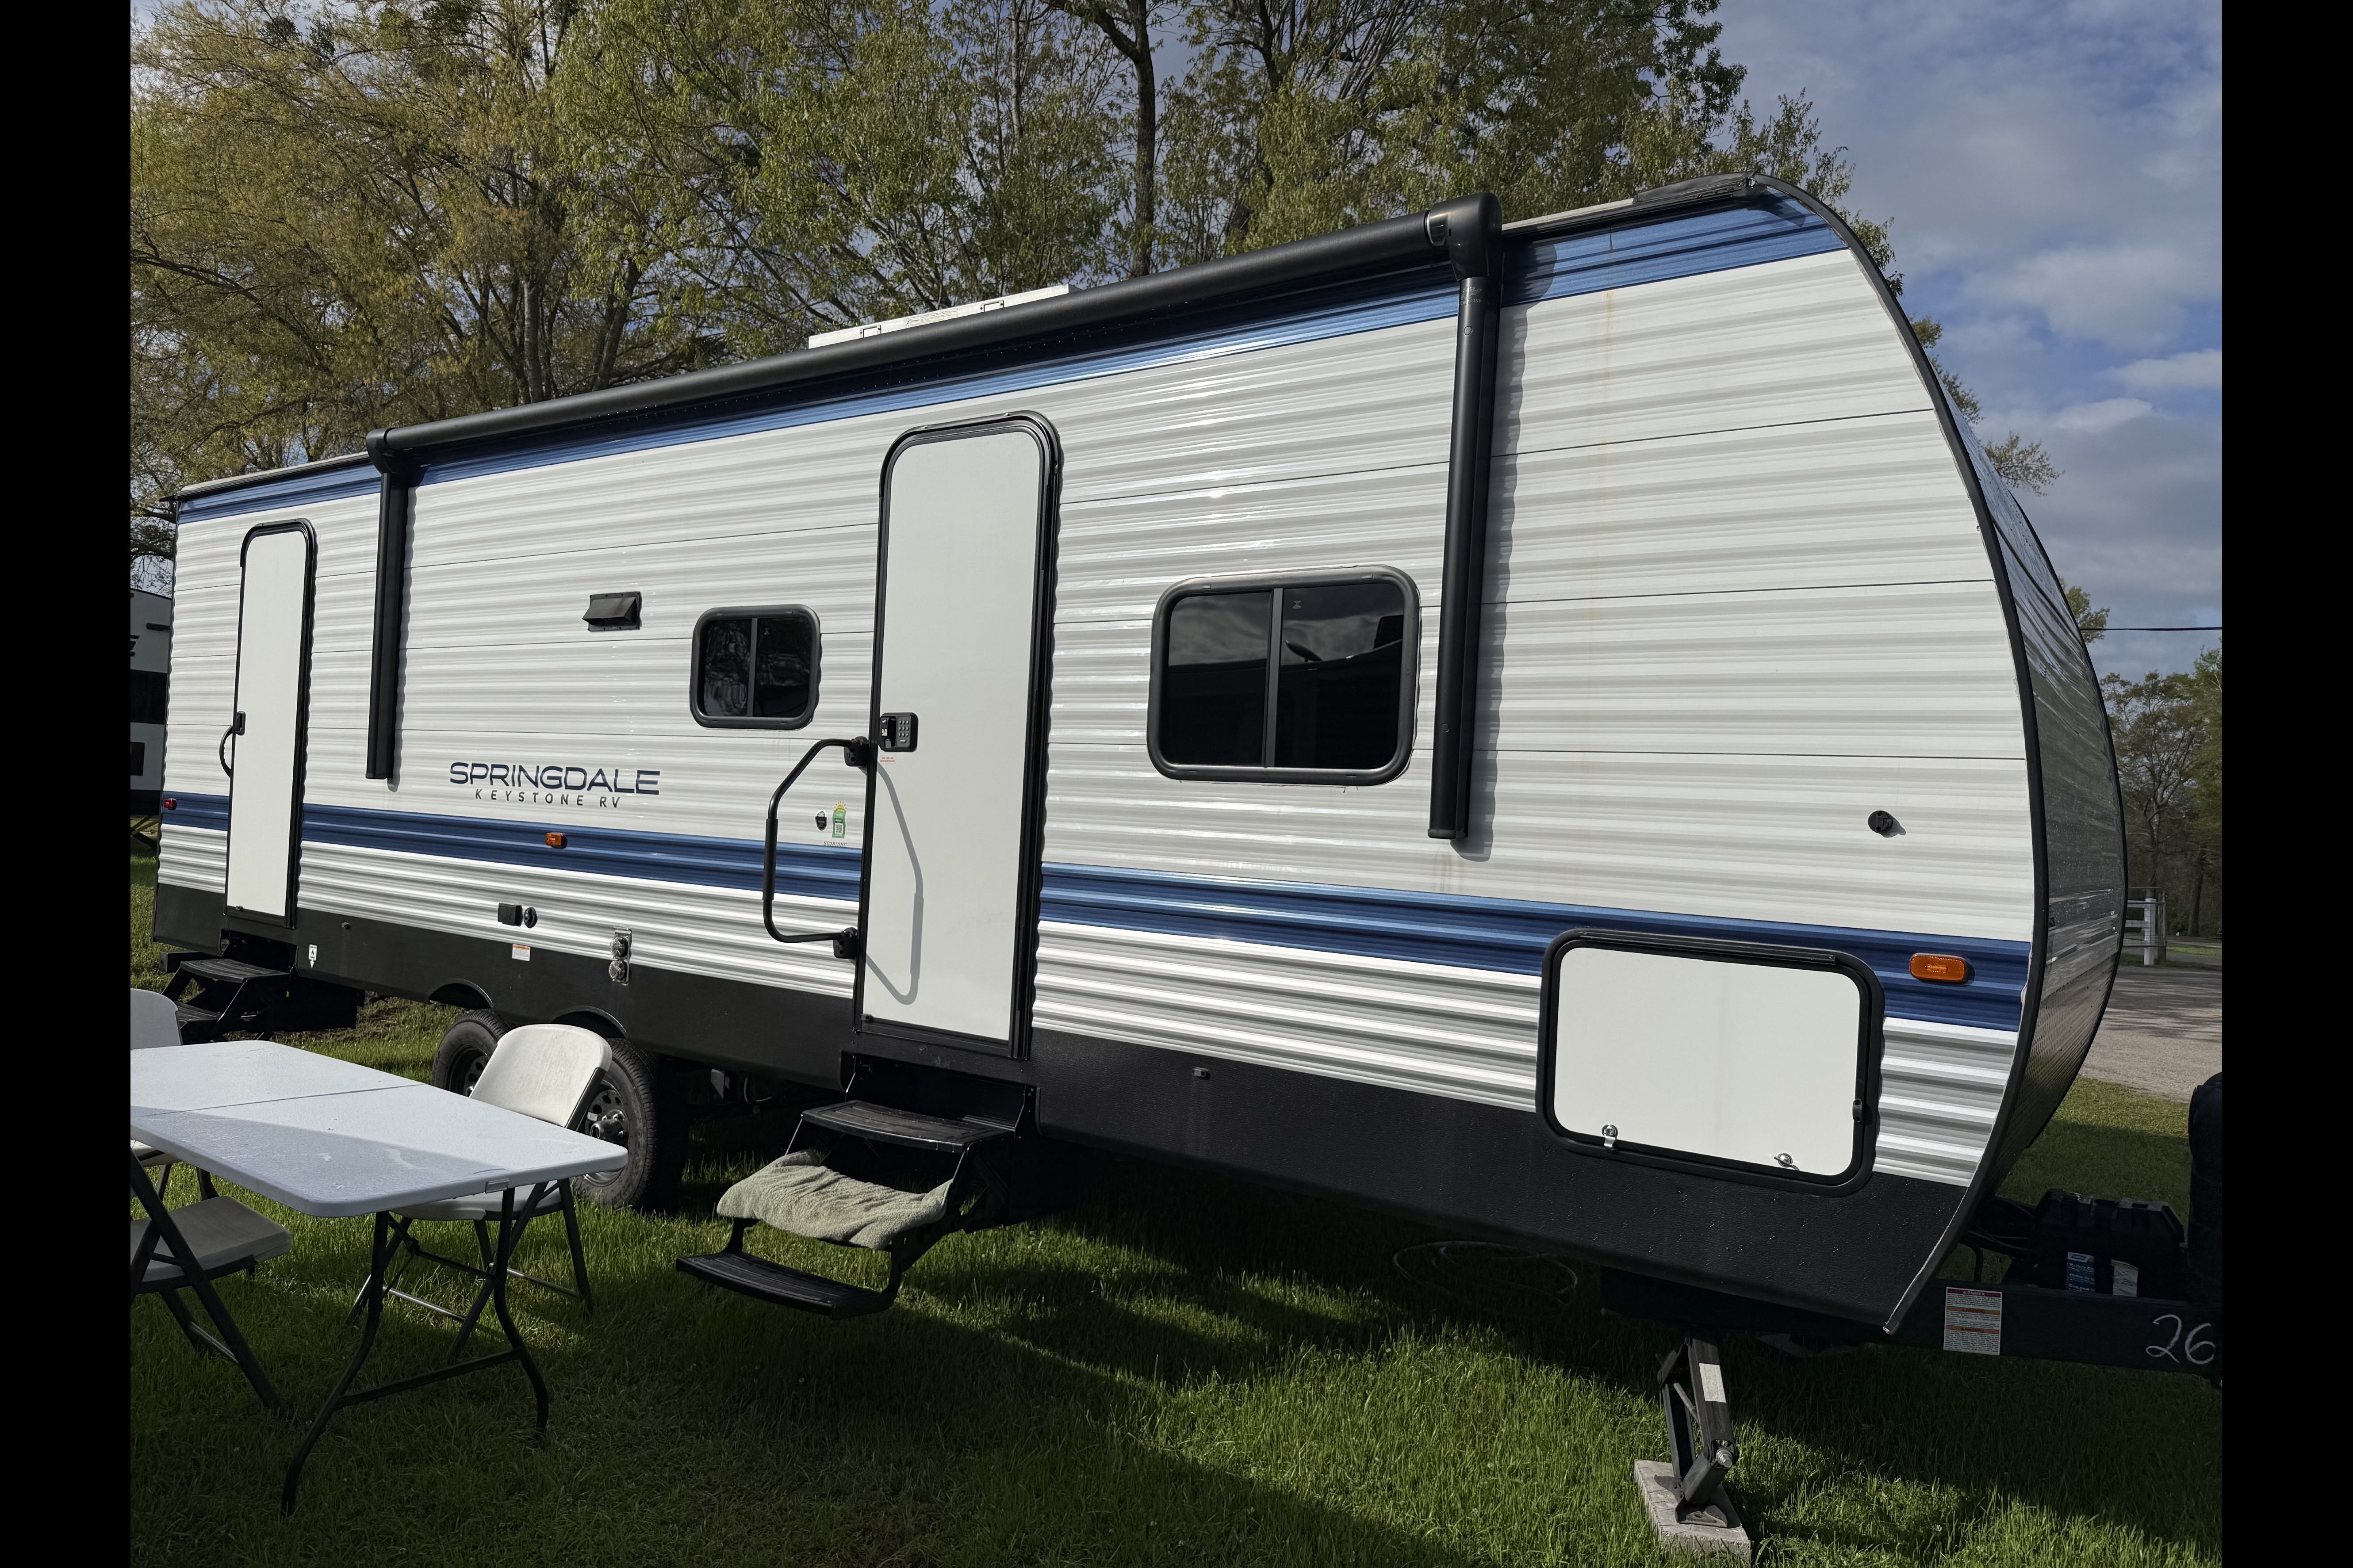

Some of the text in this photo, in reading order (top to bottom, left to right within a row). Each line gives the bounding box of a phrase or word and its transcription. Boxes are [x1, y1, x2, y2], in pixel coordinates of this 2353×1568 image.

[450, 762, 660, 795] SPRINGDALE
[475, 788, 620, 808] KEYSTONE RV
[2146, 1314, 2215, 1364] 26
